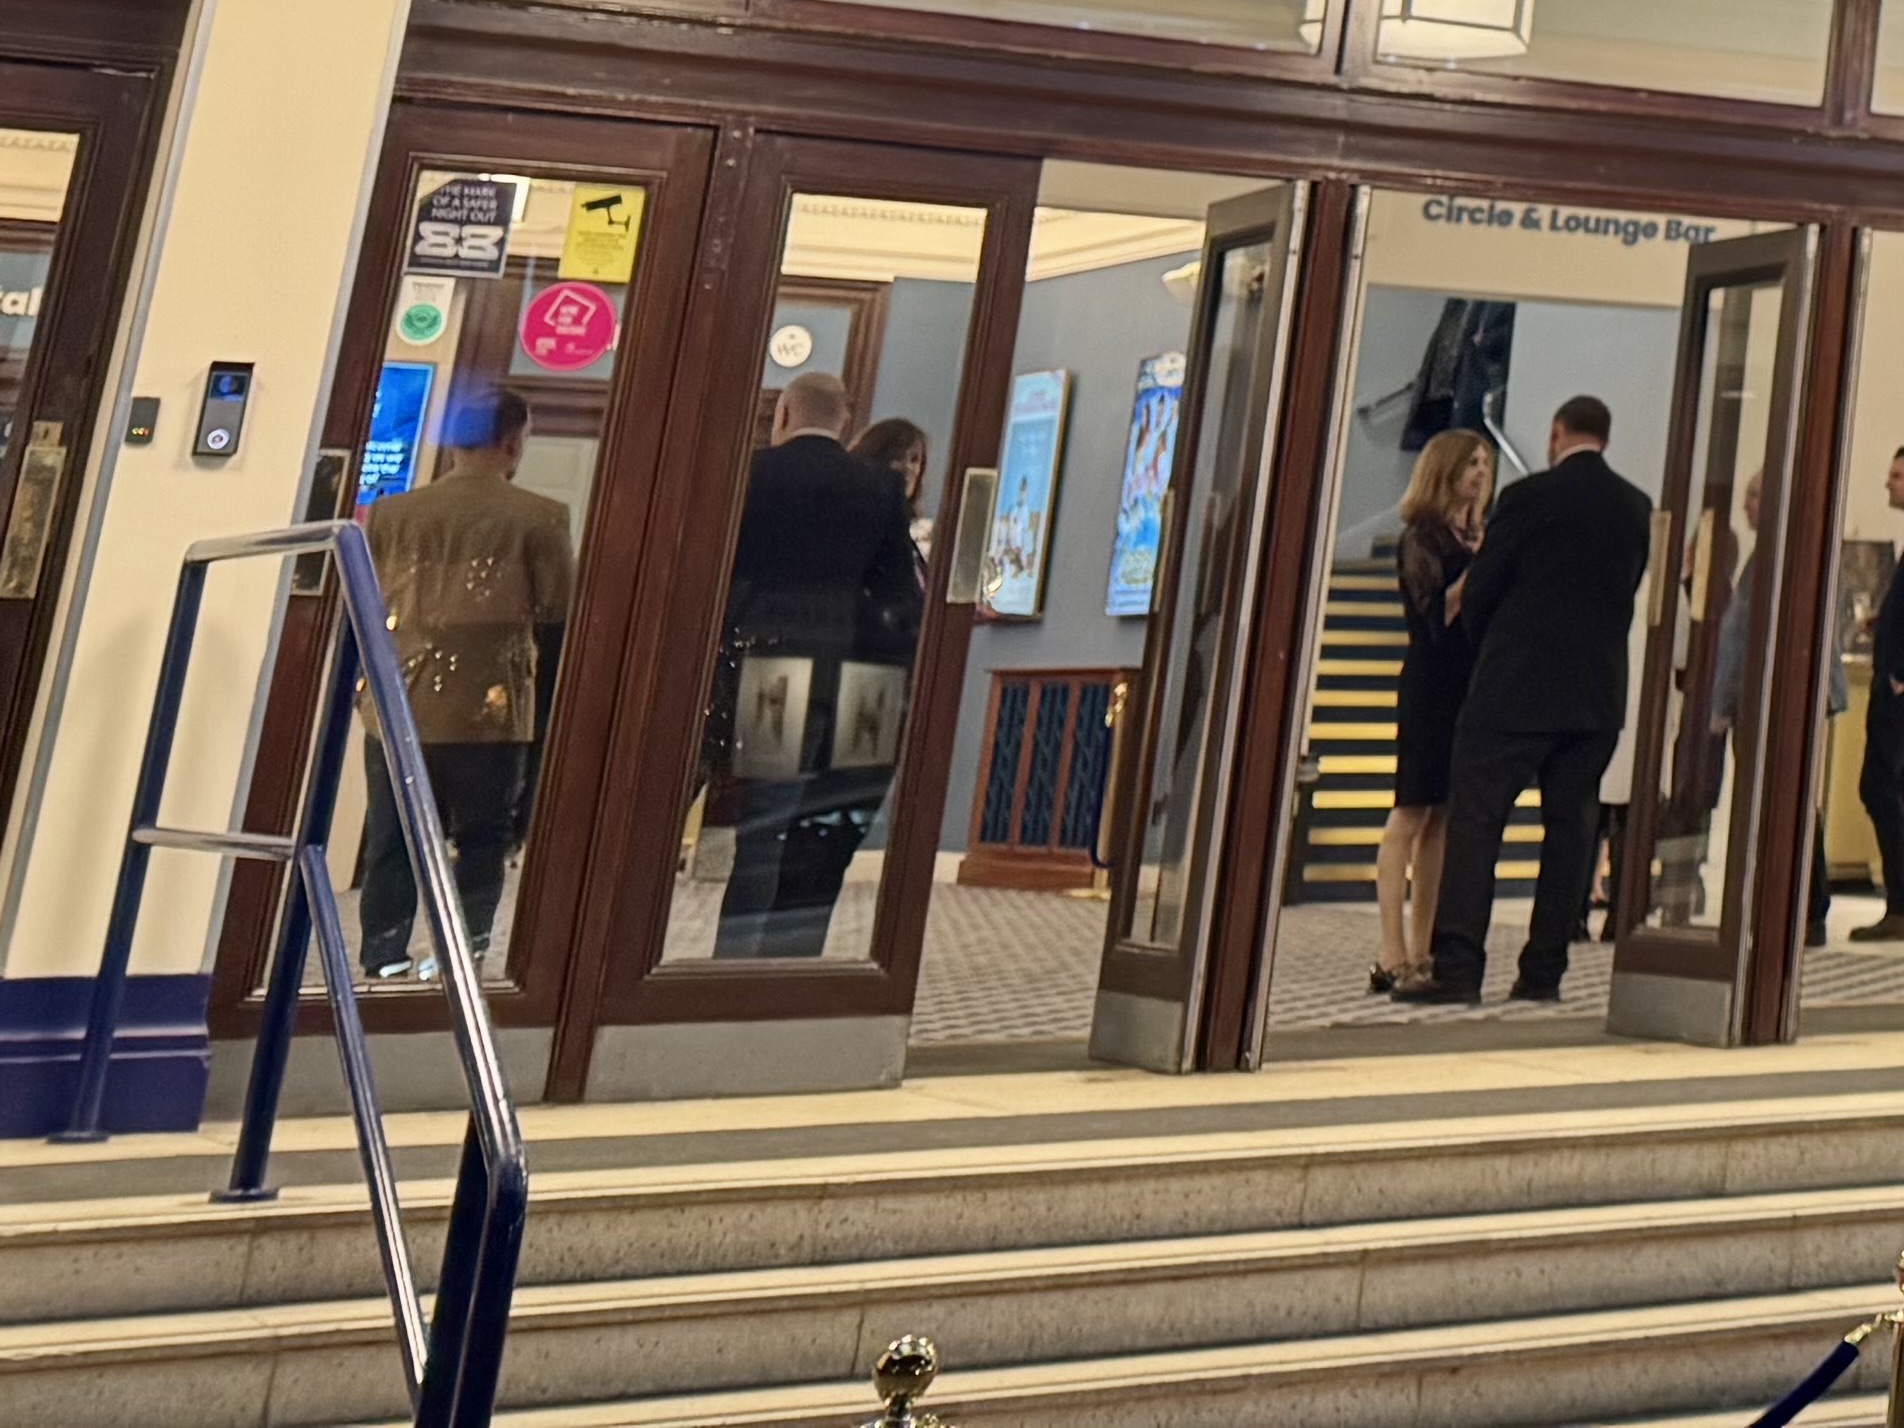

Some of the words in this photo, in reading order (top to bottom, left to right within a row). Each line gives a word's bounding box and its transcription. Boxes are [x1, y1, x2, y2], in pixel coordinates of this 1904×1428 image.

[440, 185, 462, 196] THE
[464, 185, 496, 197] MARK
[433, 196, 449, 207] OF
[451, 197, 461, 208] A
[463, 197, 498, 209] SAFER
[431, 208, 468, 220] NIGHT
[470, 210, 496, 223] OUT
[1422, 195, 1514, 227] Circle
[1519, 206, 1541, 231] &
[1550, 208, 1658, 246] Lounge
[1664, 219, 1716, 243] Bar
